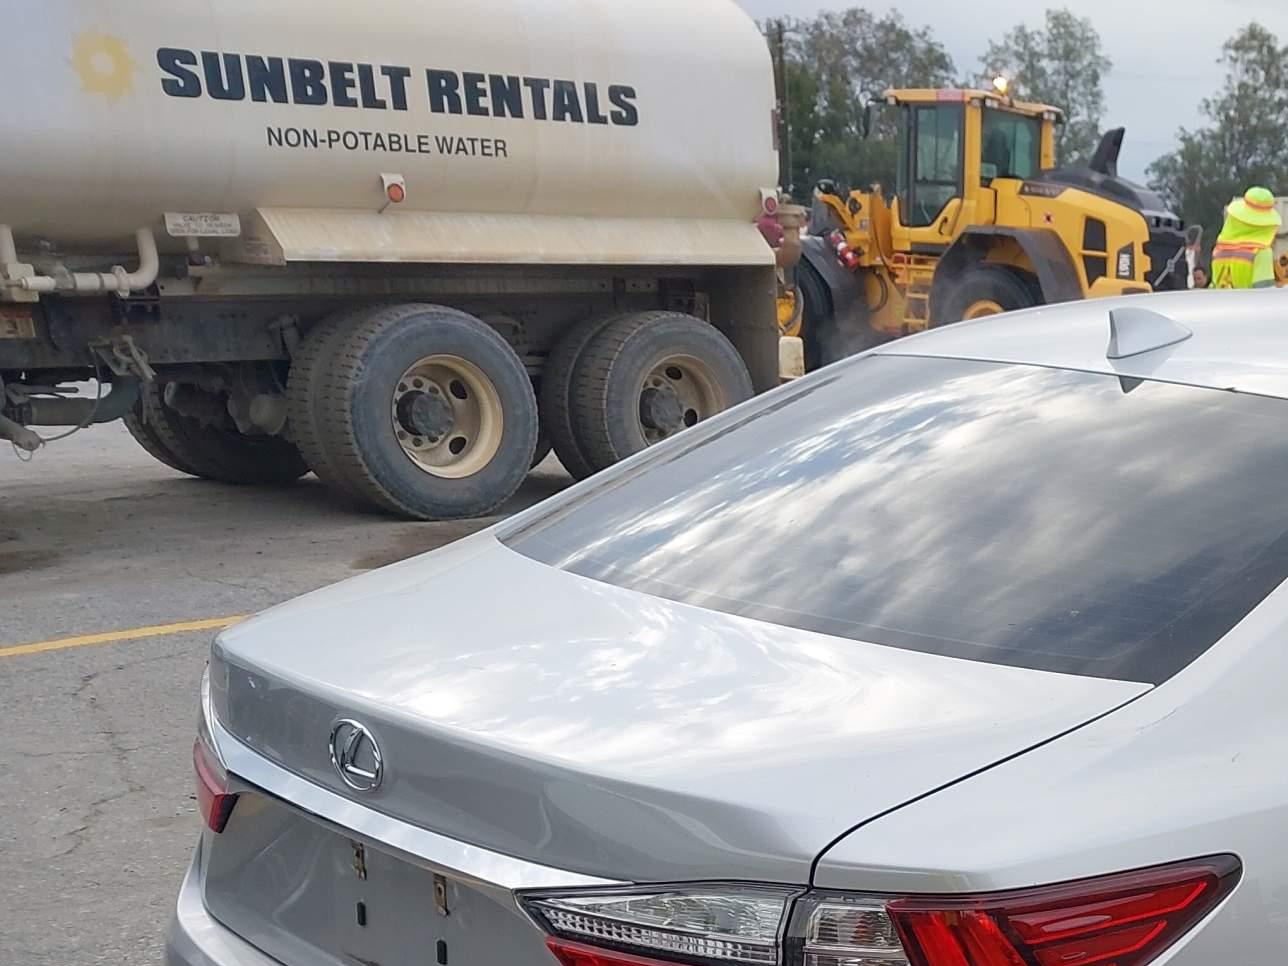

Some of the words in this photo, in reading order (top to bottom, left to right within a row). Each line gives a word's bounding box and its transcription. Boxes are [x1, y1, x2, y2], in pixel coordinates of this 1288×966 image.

[156, 47, 411, 111] SUNBELT
[425, 68, 638, 127] RENTALS
[266, 126, 430, 154] NON-POTABLE
[434, 135, 508, 157] WATER
